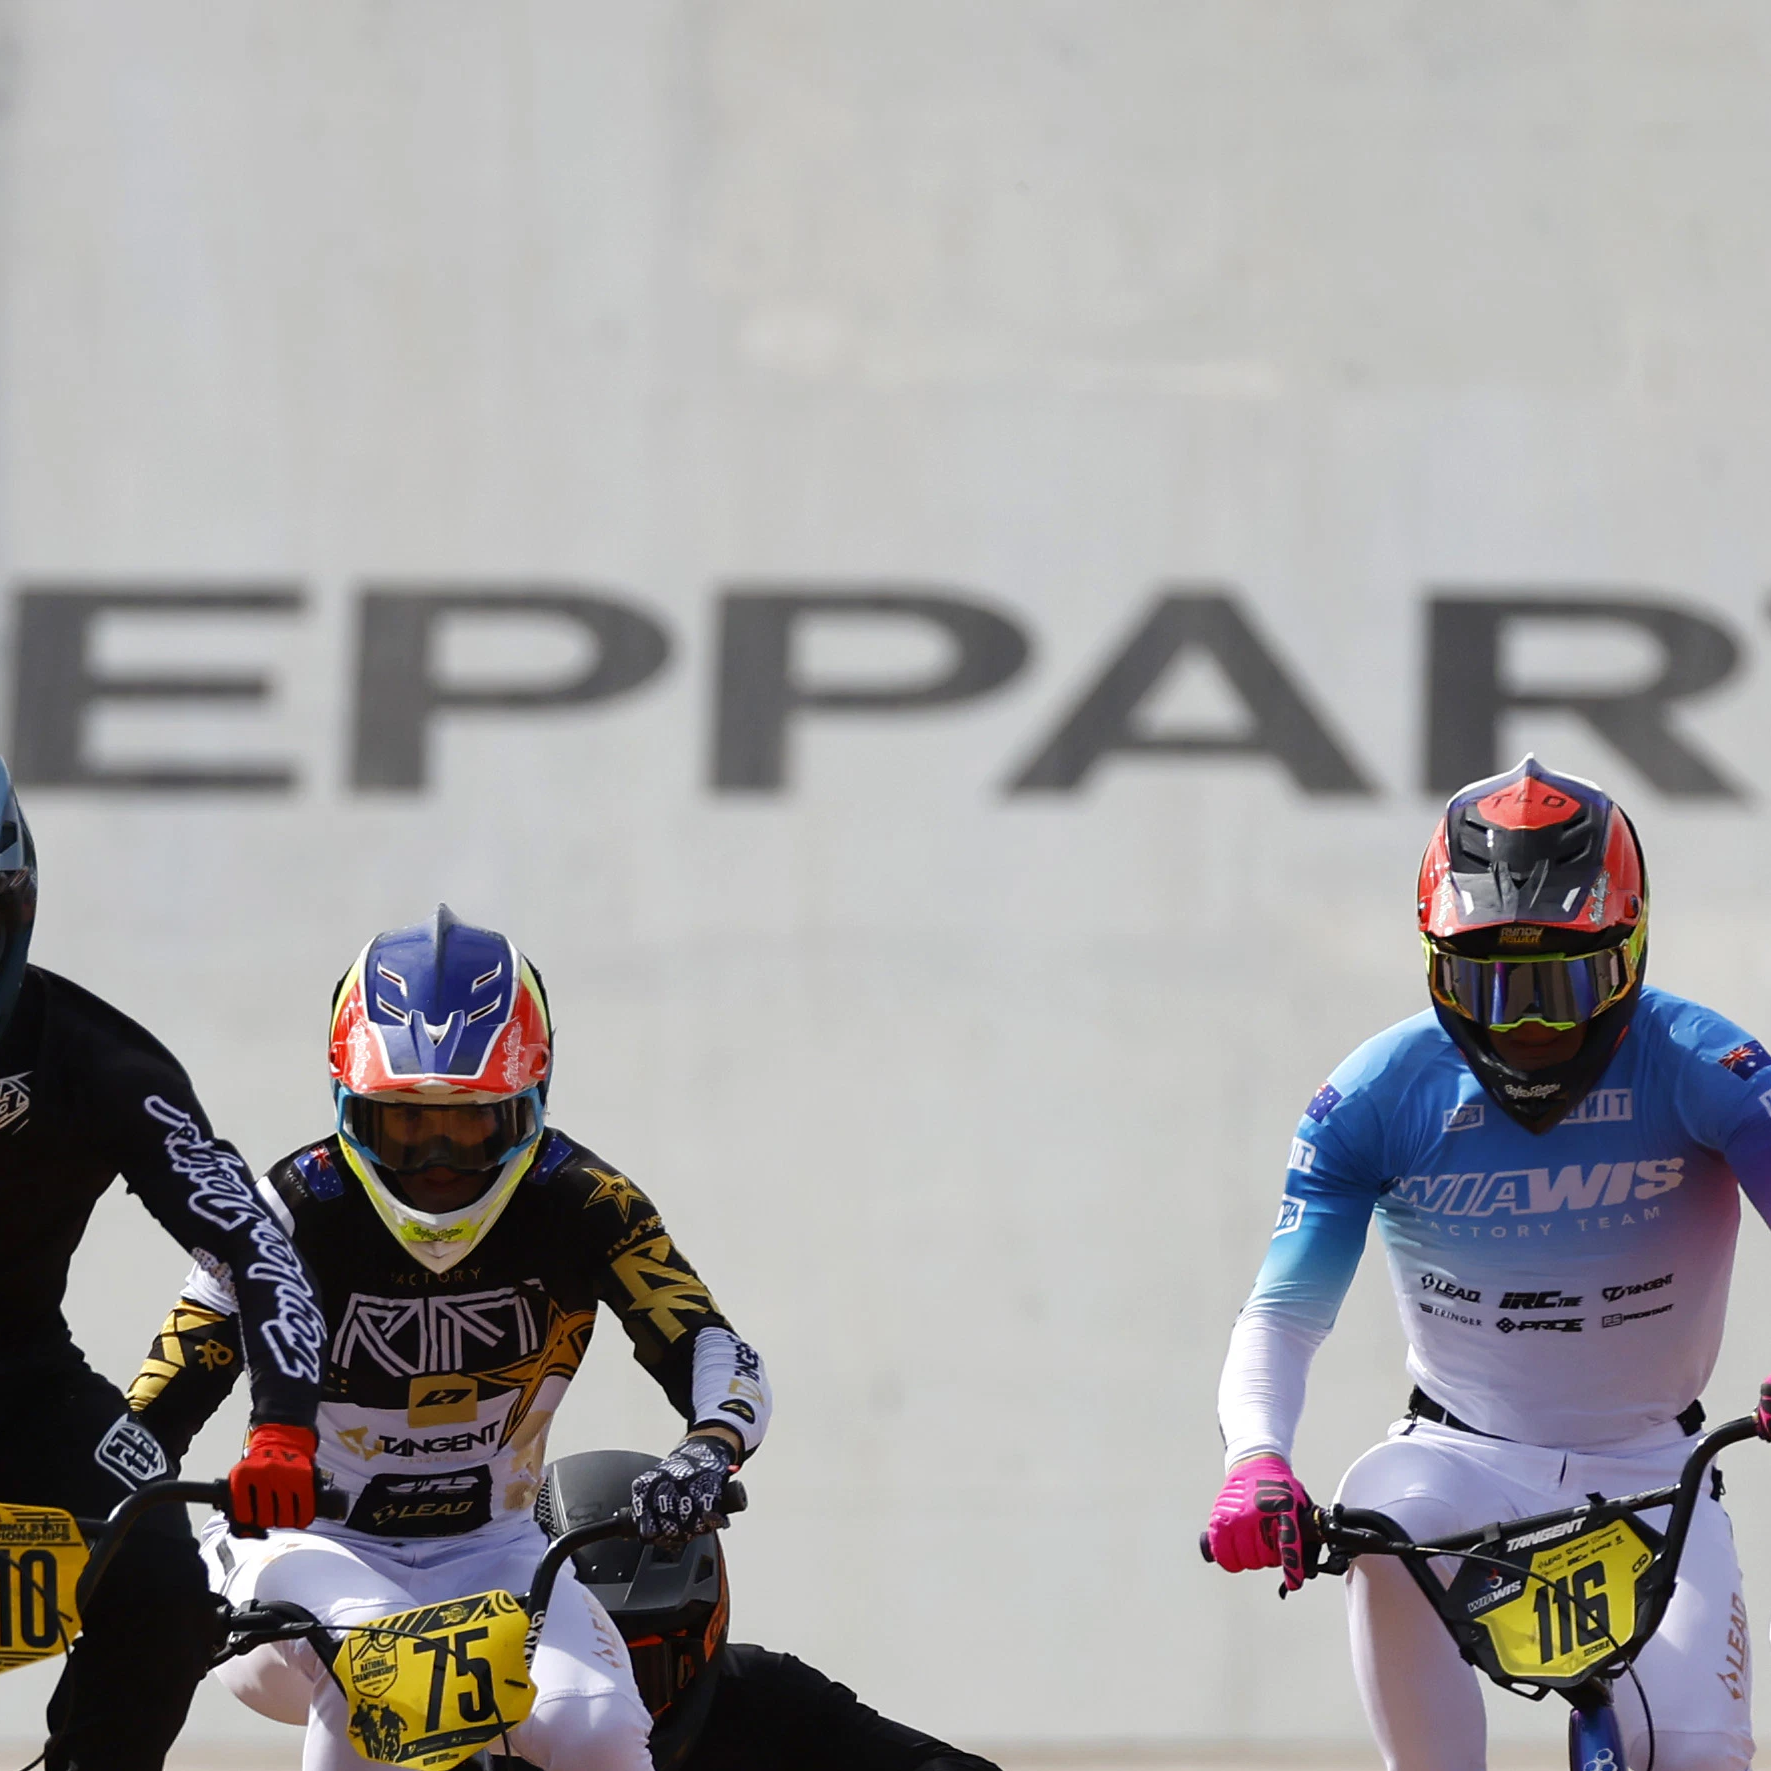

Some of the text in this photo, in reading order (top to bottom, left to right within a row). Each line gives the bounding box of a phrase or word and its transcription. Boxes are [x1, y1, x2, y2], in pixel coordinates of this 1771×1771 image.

[1389, 1157, 1685, 1218] WIAWIS
[1578, 1205, 1662, 1233] TEAM
[1433, 1278, 1482, 1303] LEAD
[1625, 1272, 1675, 1298] TANGENT
[379, 1420, 501, 1458] TANGENT
[397, 1501, 474, 1520] LEAD
[1505, 1516, 1587, 1553] TANGENT
[1467, 1579, 1522, 1613] WIAWIS
[1533, 1560, 1612, 1665] 116
[412, 1626, 497, 1734] 75
